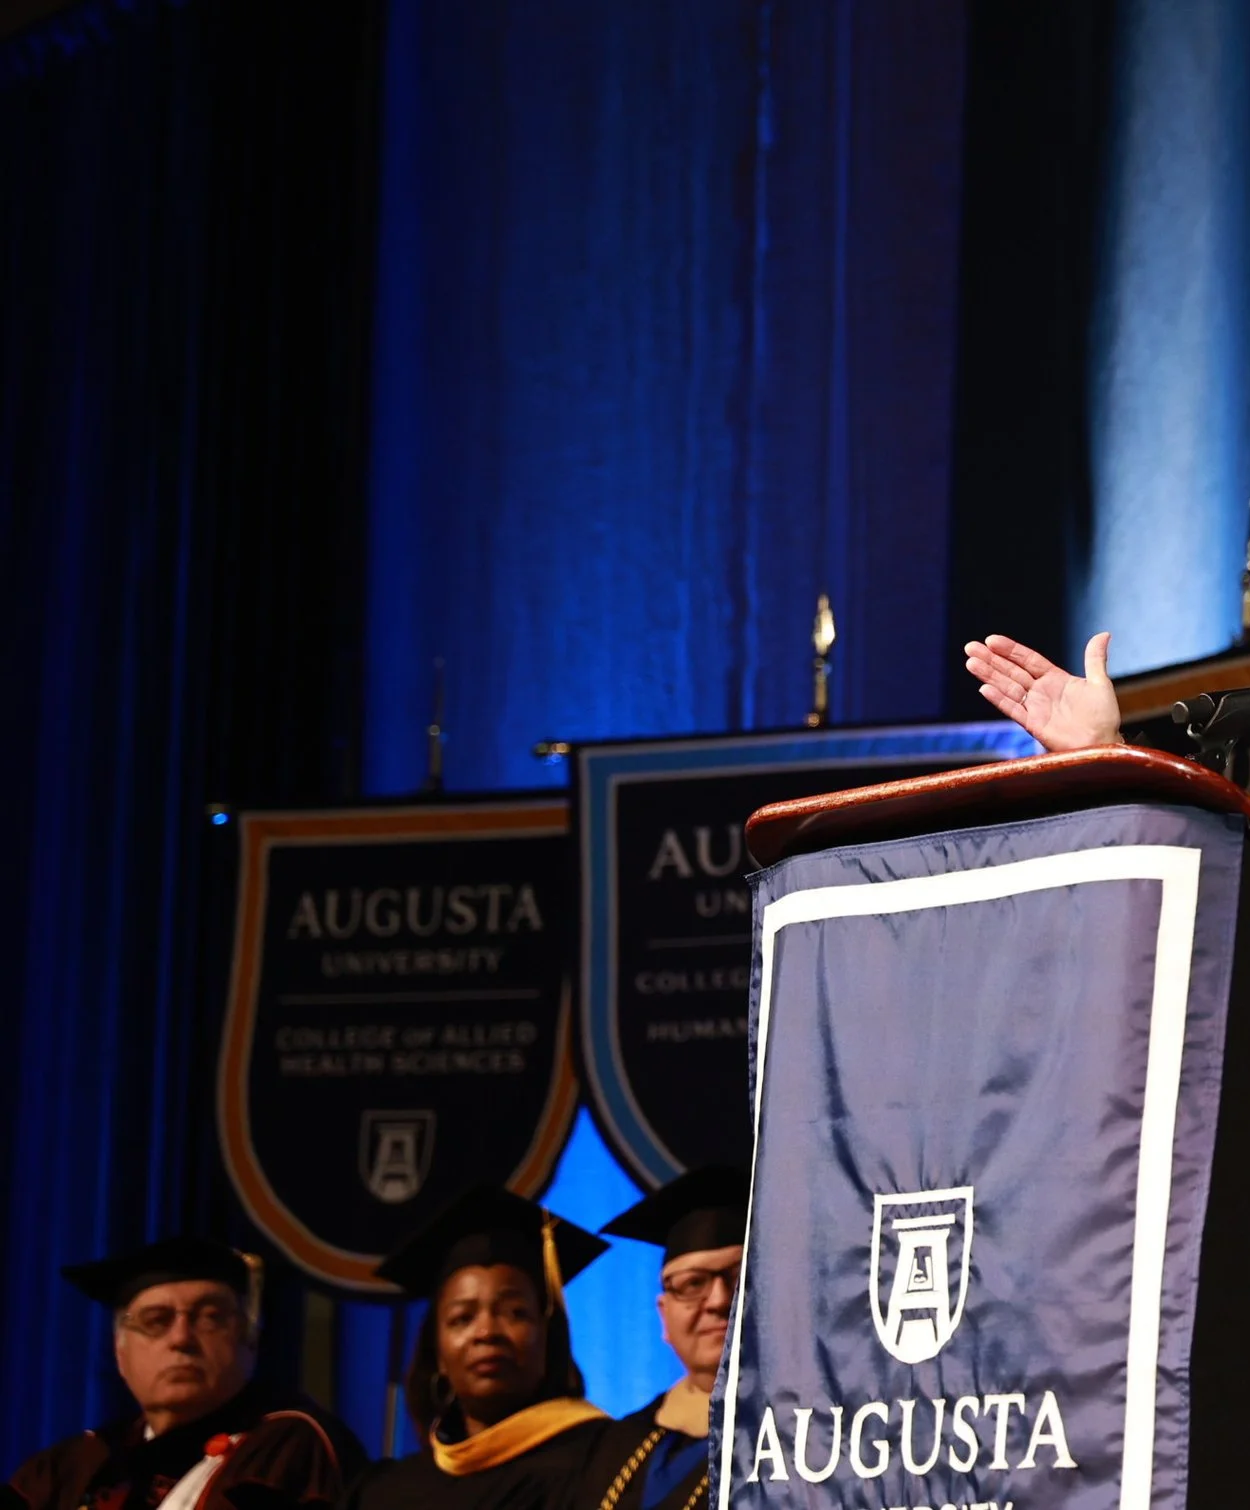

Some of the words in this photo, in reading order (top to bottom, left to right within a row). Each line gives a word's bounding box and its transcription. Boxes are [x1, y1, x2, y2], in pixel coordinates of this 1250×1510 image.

[286, 881, 545, 941] AUGUSTA
[320, 946, 505, 980] UNIVERSITY
[274, 1023, 397, 1052] COLLEGE
[440, 1019, 539, 1048] ALLIED
[278, 1050, 386, 1078] HEALTH
[391, 1048, 527, 1077] SCIENCES
[747, 1390, 1078, 1484] AUGUSTA
